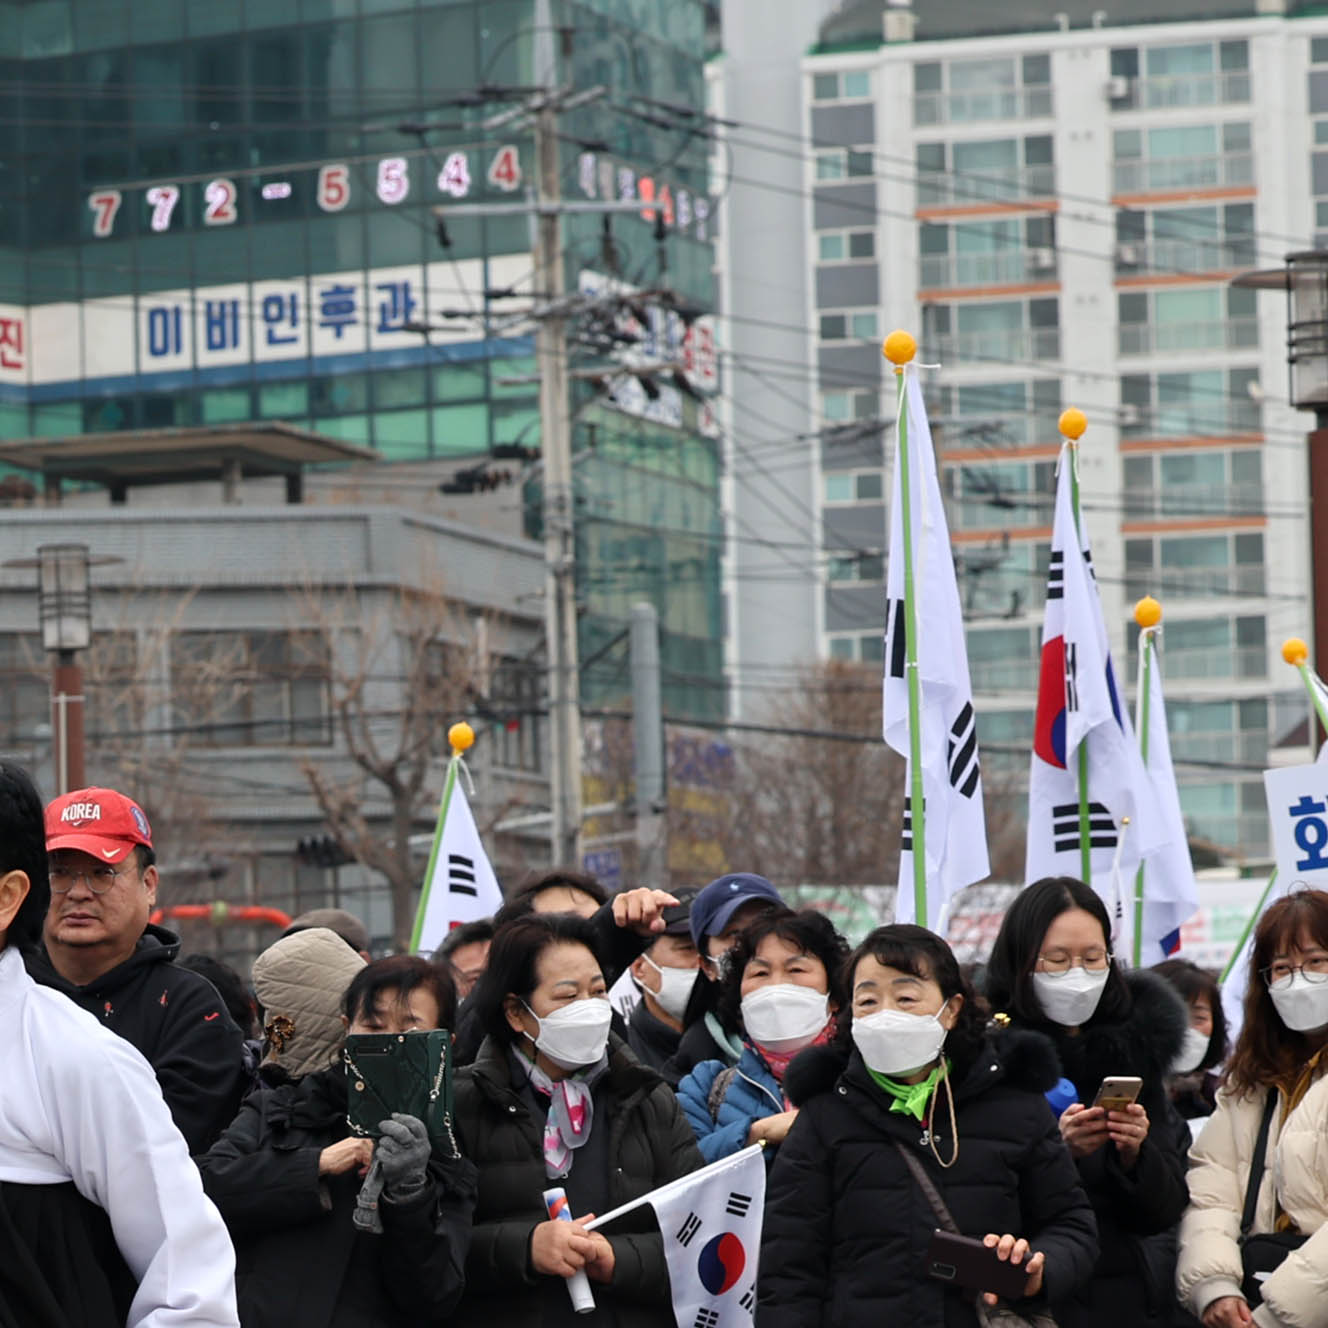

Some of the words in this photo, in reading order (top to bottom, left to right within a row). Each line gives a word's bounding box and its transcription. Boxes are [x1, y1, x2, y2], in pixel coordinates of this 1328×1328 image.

[88, 144, 522, 238] 772-5544
[148, 280, 418, 358] 이비인후과
[60, 803, 102, 822] KOREA
